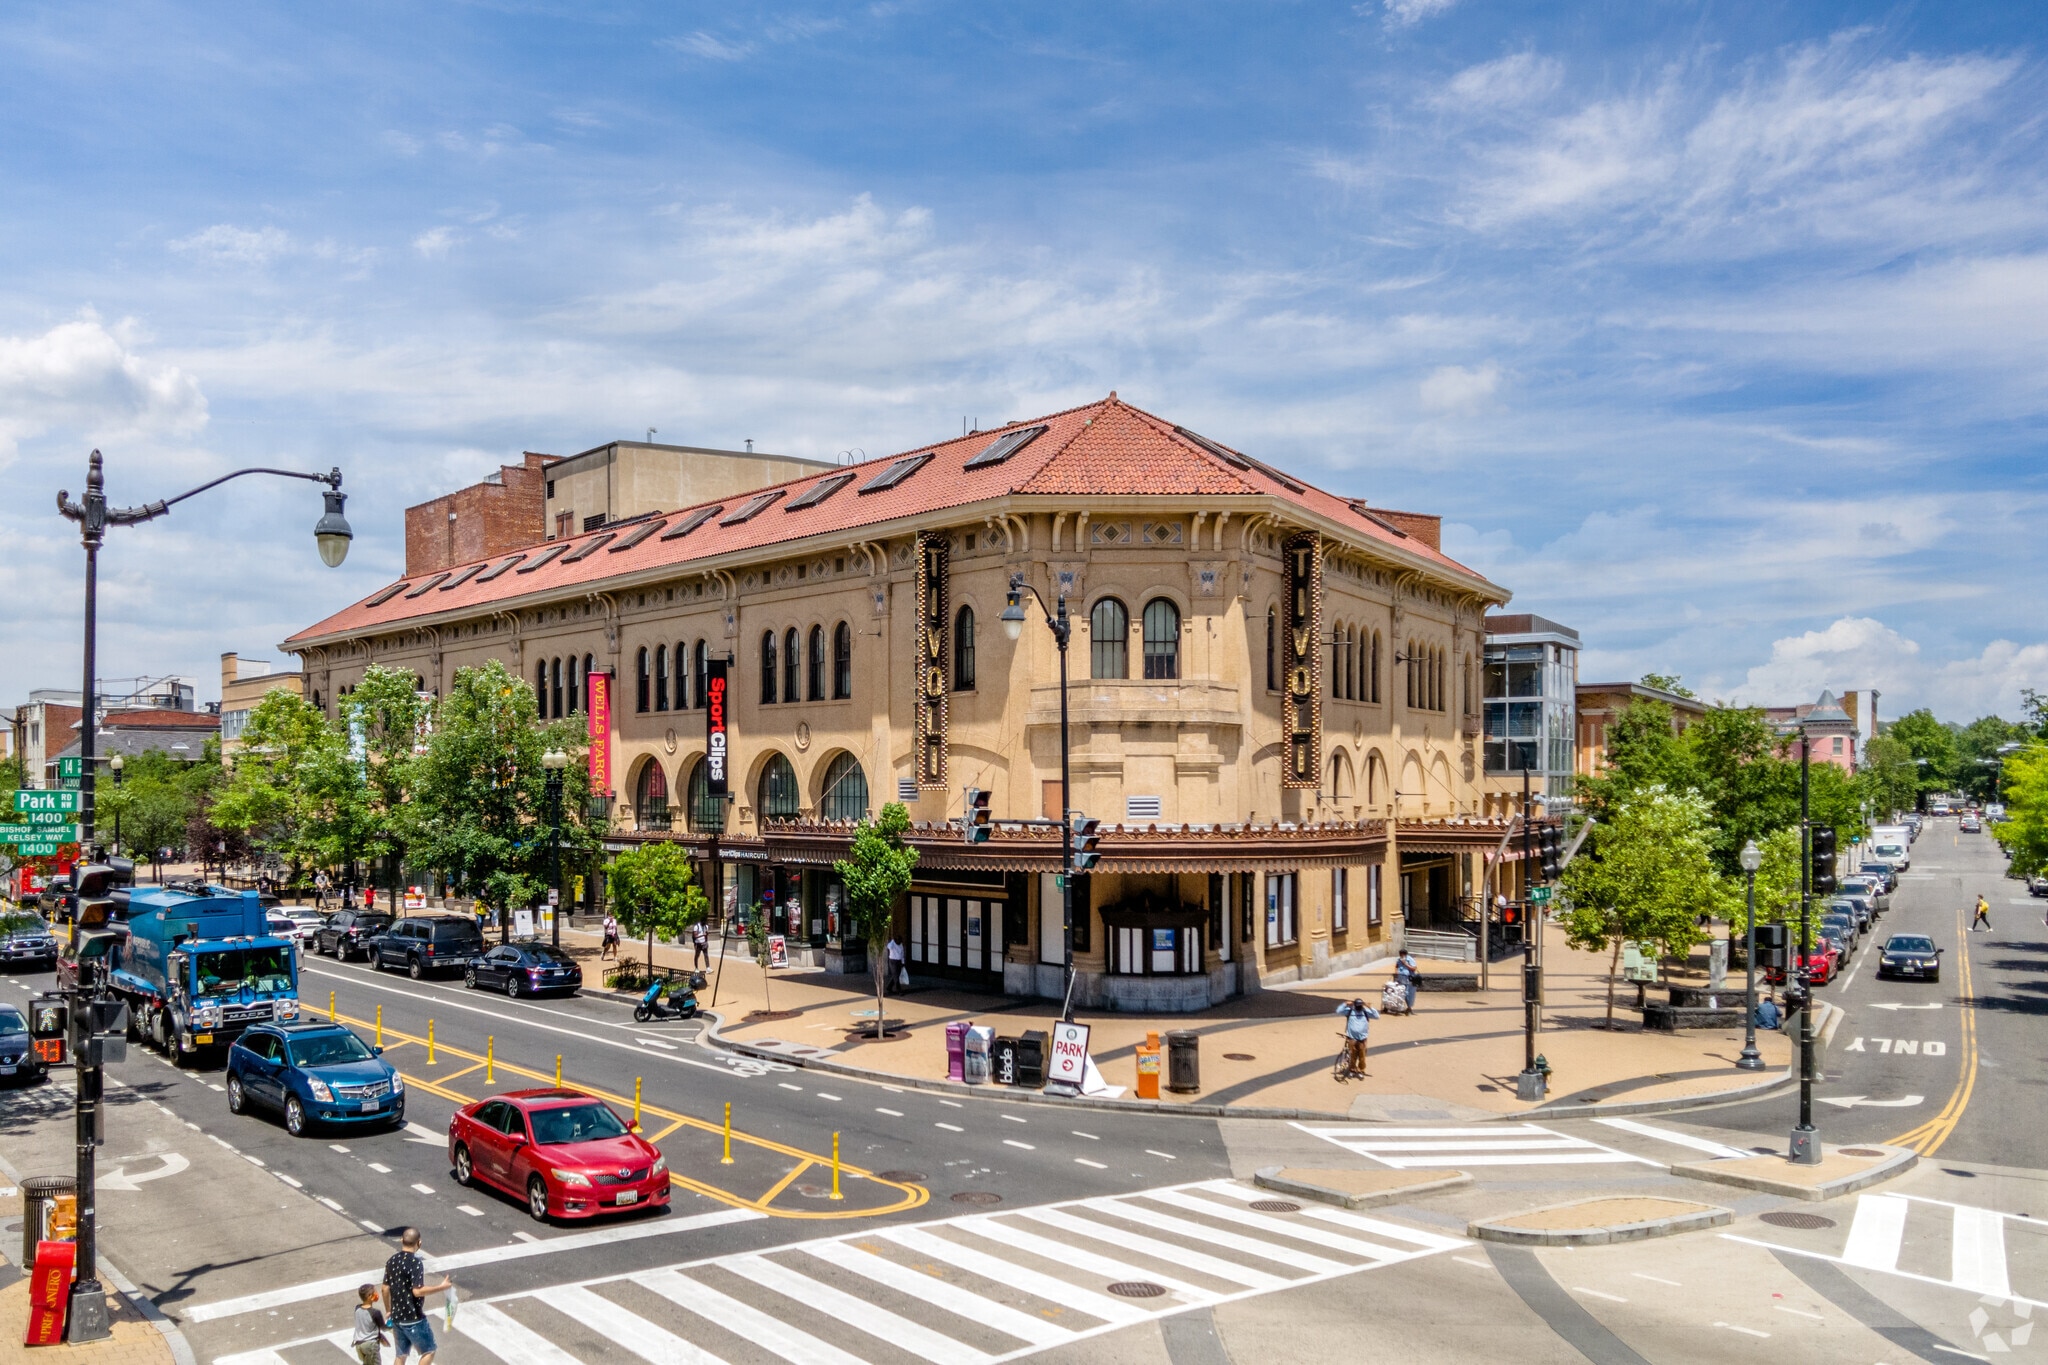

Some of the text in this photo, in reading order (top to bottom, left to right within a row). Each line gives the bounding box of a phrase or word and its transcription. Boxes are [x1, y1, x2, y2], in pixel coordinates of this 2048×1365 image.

[927, 548, 942, 778] TIVOLI
[1292, 548, 1311, 774] TIVOLI
[595, 679, 605, 734] WELLS
[65, 760, 73, 774] 14
[20, 793, 55, 809] Park
[31, 813, 62, 823] 1400
[22, 844, 53, 854] 1400
[229, 1011, 266, 1019] MACK
[34, 1040, 60, 1062] 43
[1055, 1040, 1085, 1058] PARK
[1844, 1037, 1946, 1056] ONLY
[1000, 1047, 1013, 1084] blade
